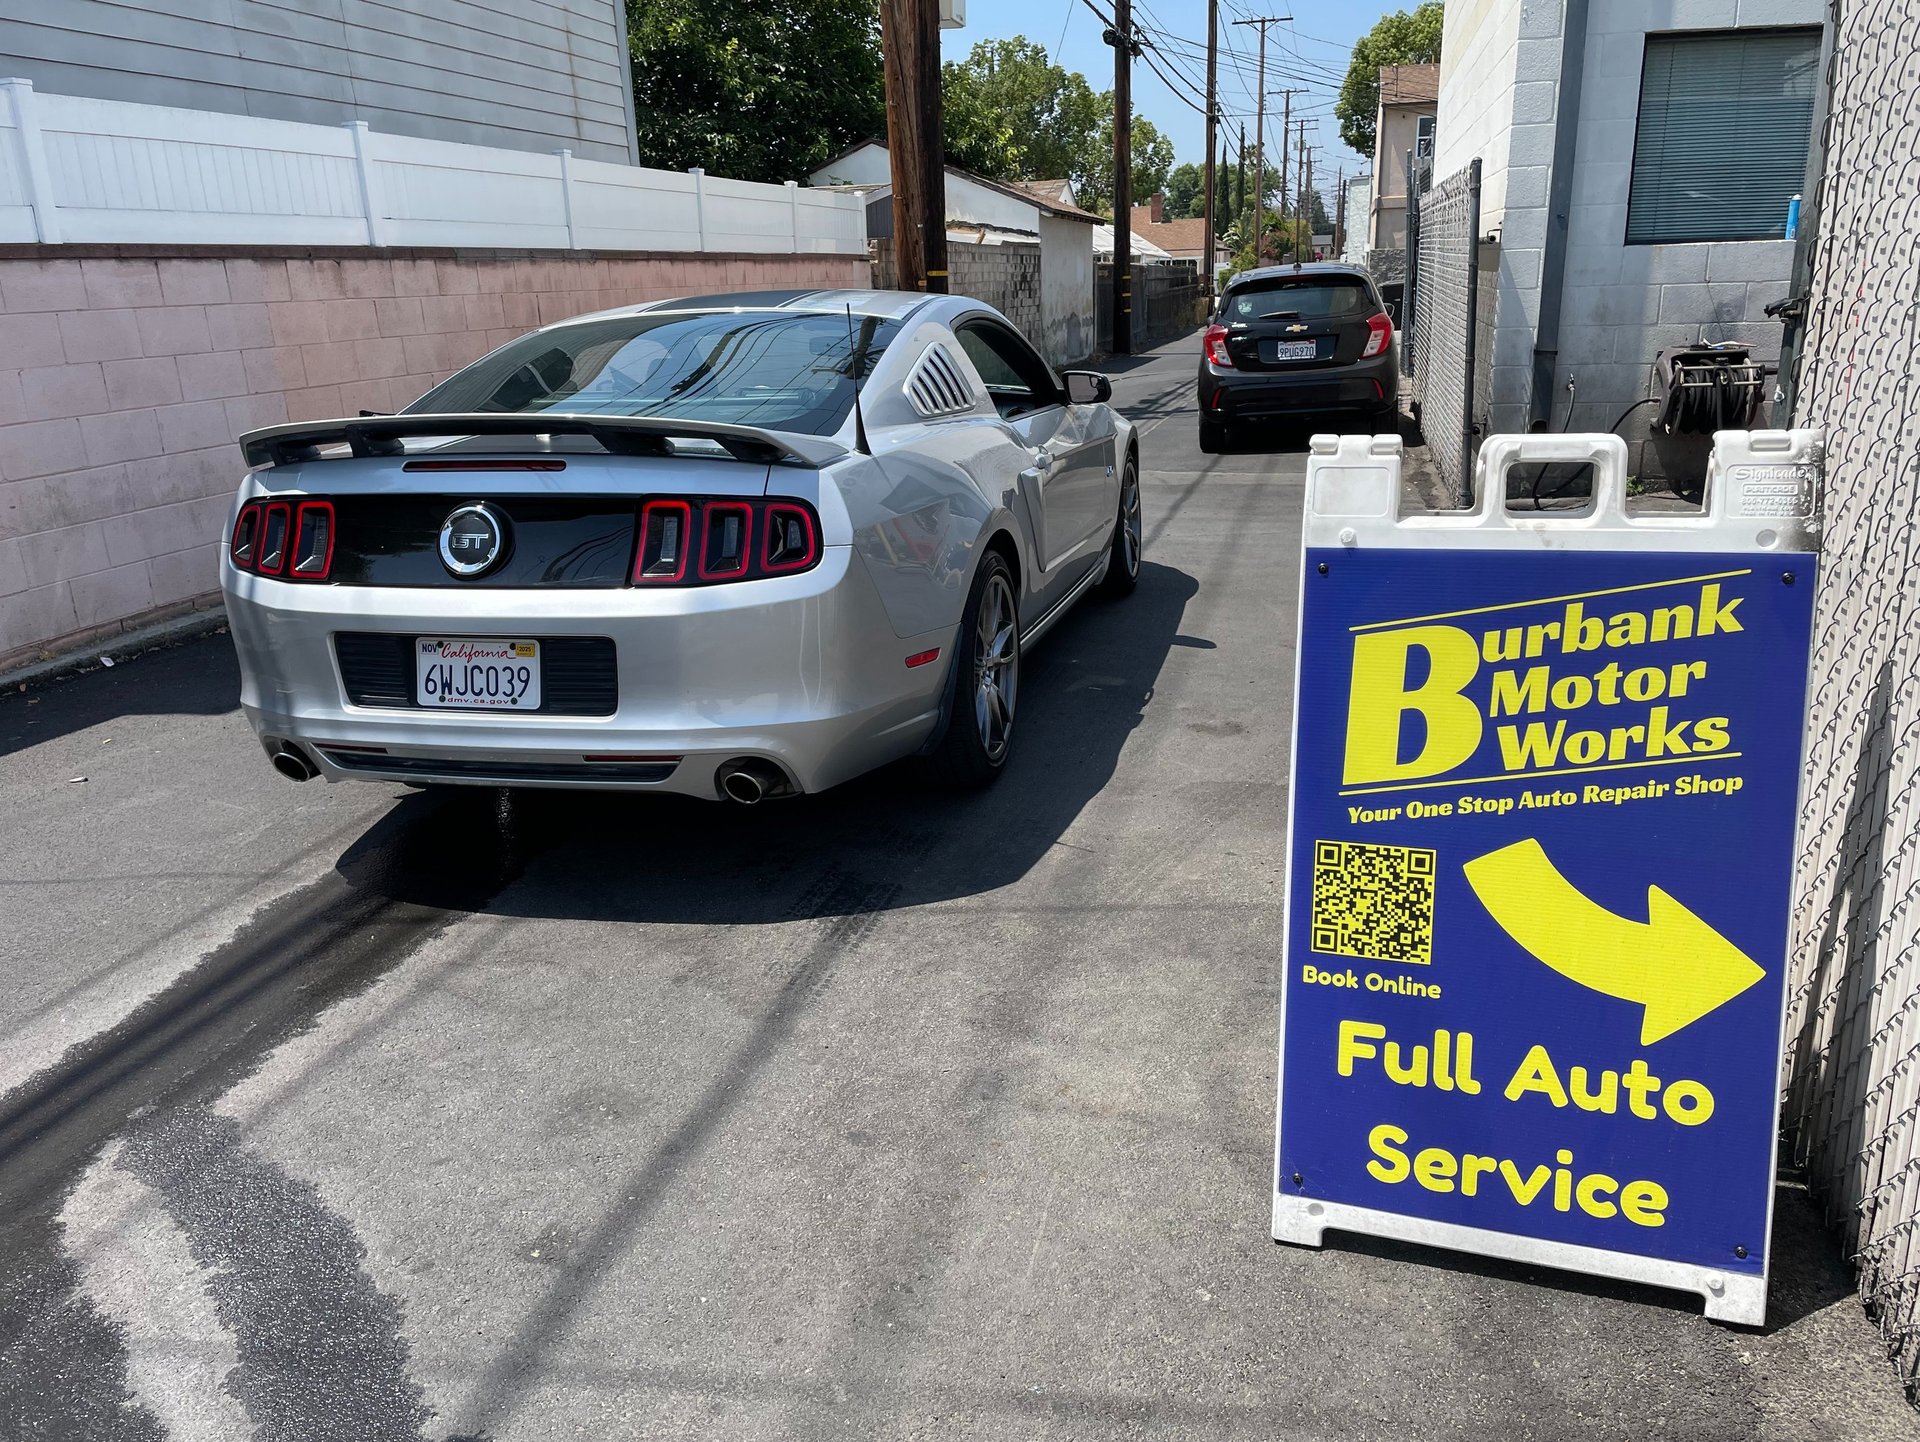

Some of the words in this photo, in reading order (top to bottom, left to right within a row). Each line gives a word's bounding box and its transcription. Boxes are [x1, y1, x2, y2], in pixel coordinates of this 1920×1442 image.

[1735, 466, 1807, 482] Signicade
[452, 533, 489, 549] GT
[421, 643, 438, 653] NOV
[441, 643, 517, 663] California
[424, 664, 531, 698] 6WJC039
[1343, 583, 1745, 786] Burbank
[1490, 660, 1707, 718] Motor
[447, 697, 510, 705] dmv.ca.gov
[1496, 706, 1731, 771] Works
[1348, 806, 1402, 824] Your
[1405, 801, 1453, 819] One
[1457, 796, 1514, 815] Stop
[1518, 790, 1578, 810] Auto
[1582, 779, 1670, 805] Repair
[1674, 774, 1744, 796] Shop
[1302, 964, 1359, 989] Book
[1364, 972, 1442, 1000] Online
[1337, 1019, 1482, 1095] Full
[1503, 1044, 1716, 1126] Auto
[1366, 1124, 1669, 1228] Service
